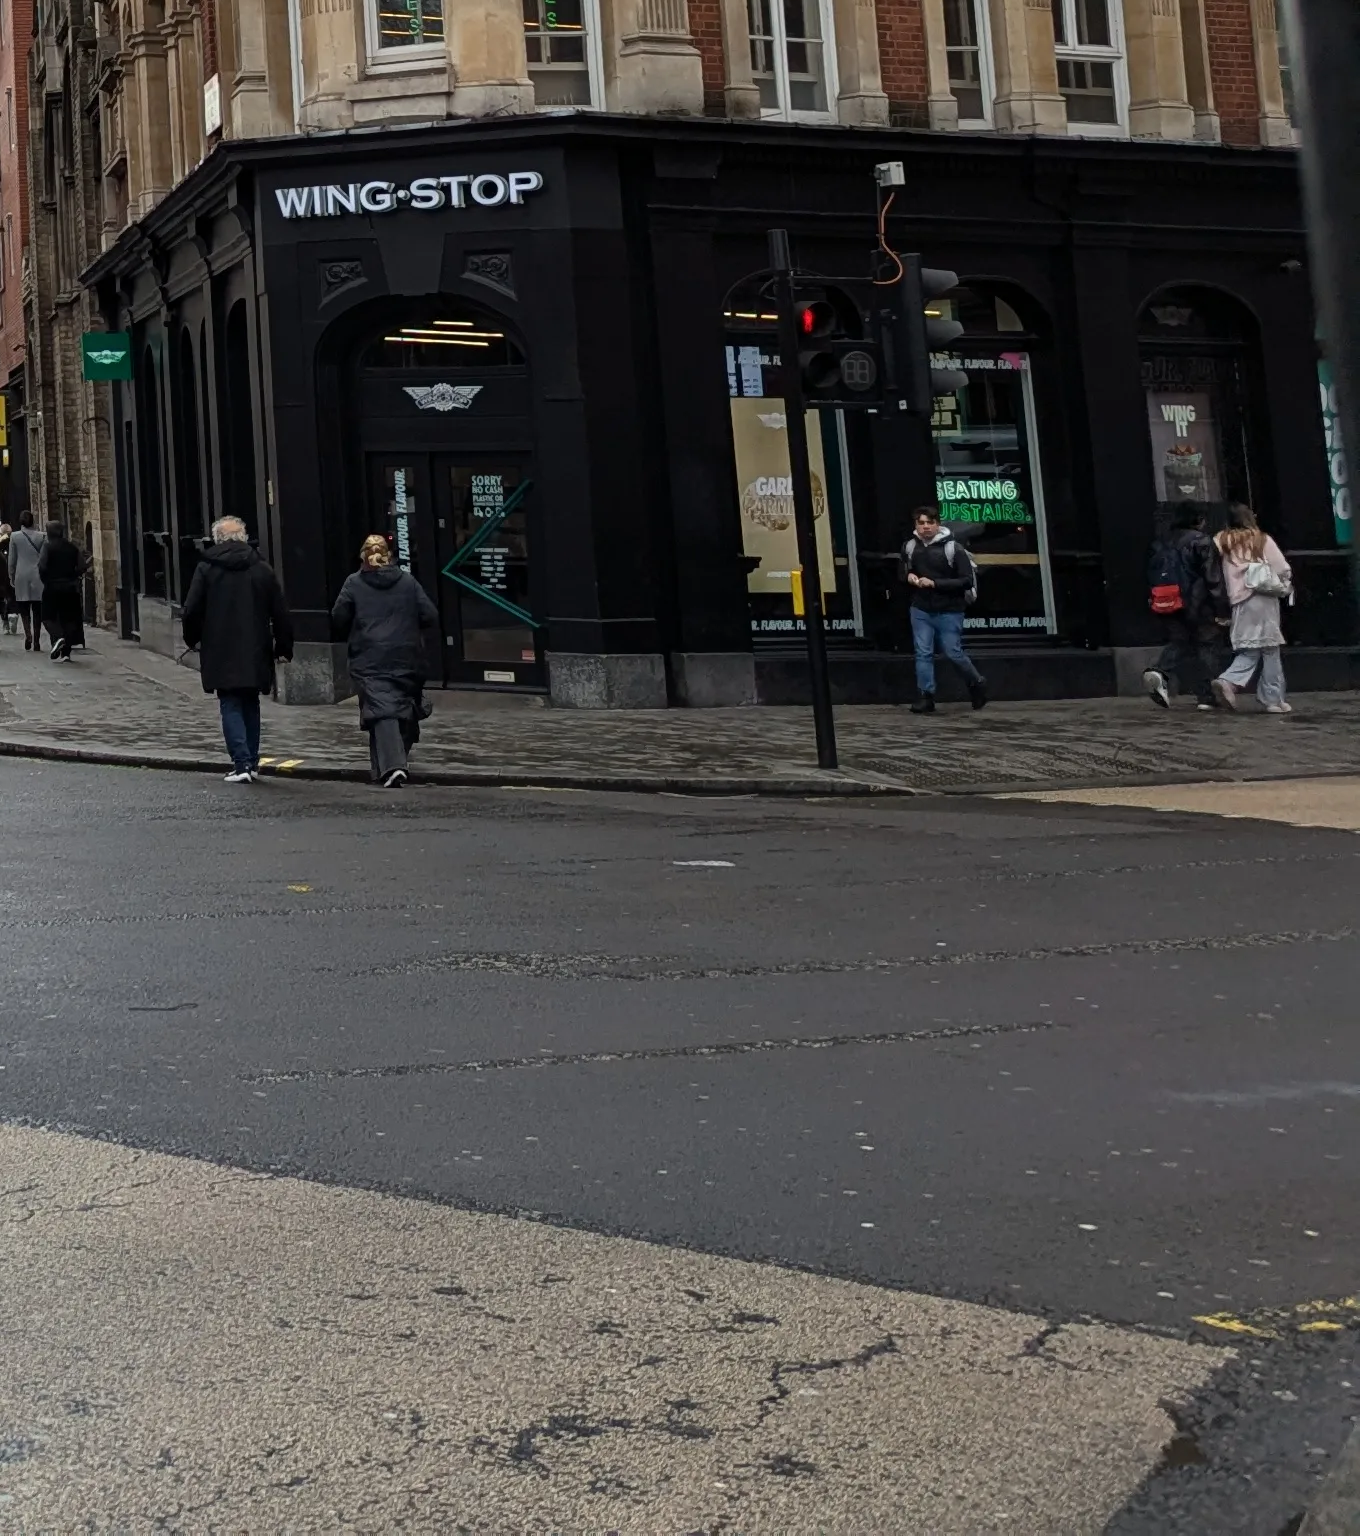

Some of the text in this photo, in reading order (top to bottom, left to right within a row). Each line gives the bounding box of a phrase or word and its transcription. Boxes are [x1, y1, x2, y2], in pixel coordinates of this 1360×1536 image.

[1161, 404, 1196, 422] WING
[1174, 421, 1188, 437] IT
[471, 475, 502, 486] SORRY
[472, 485, 503, 494] NO CASH
[755, 477, 794, 496] GARL
[394, 468, 408, 513] FLAVOUR.
[936, 480, 1018, 500] SEATING
[397, 515, 411, 560] FLAVOUR.
